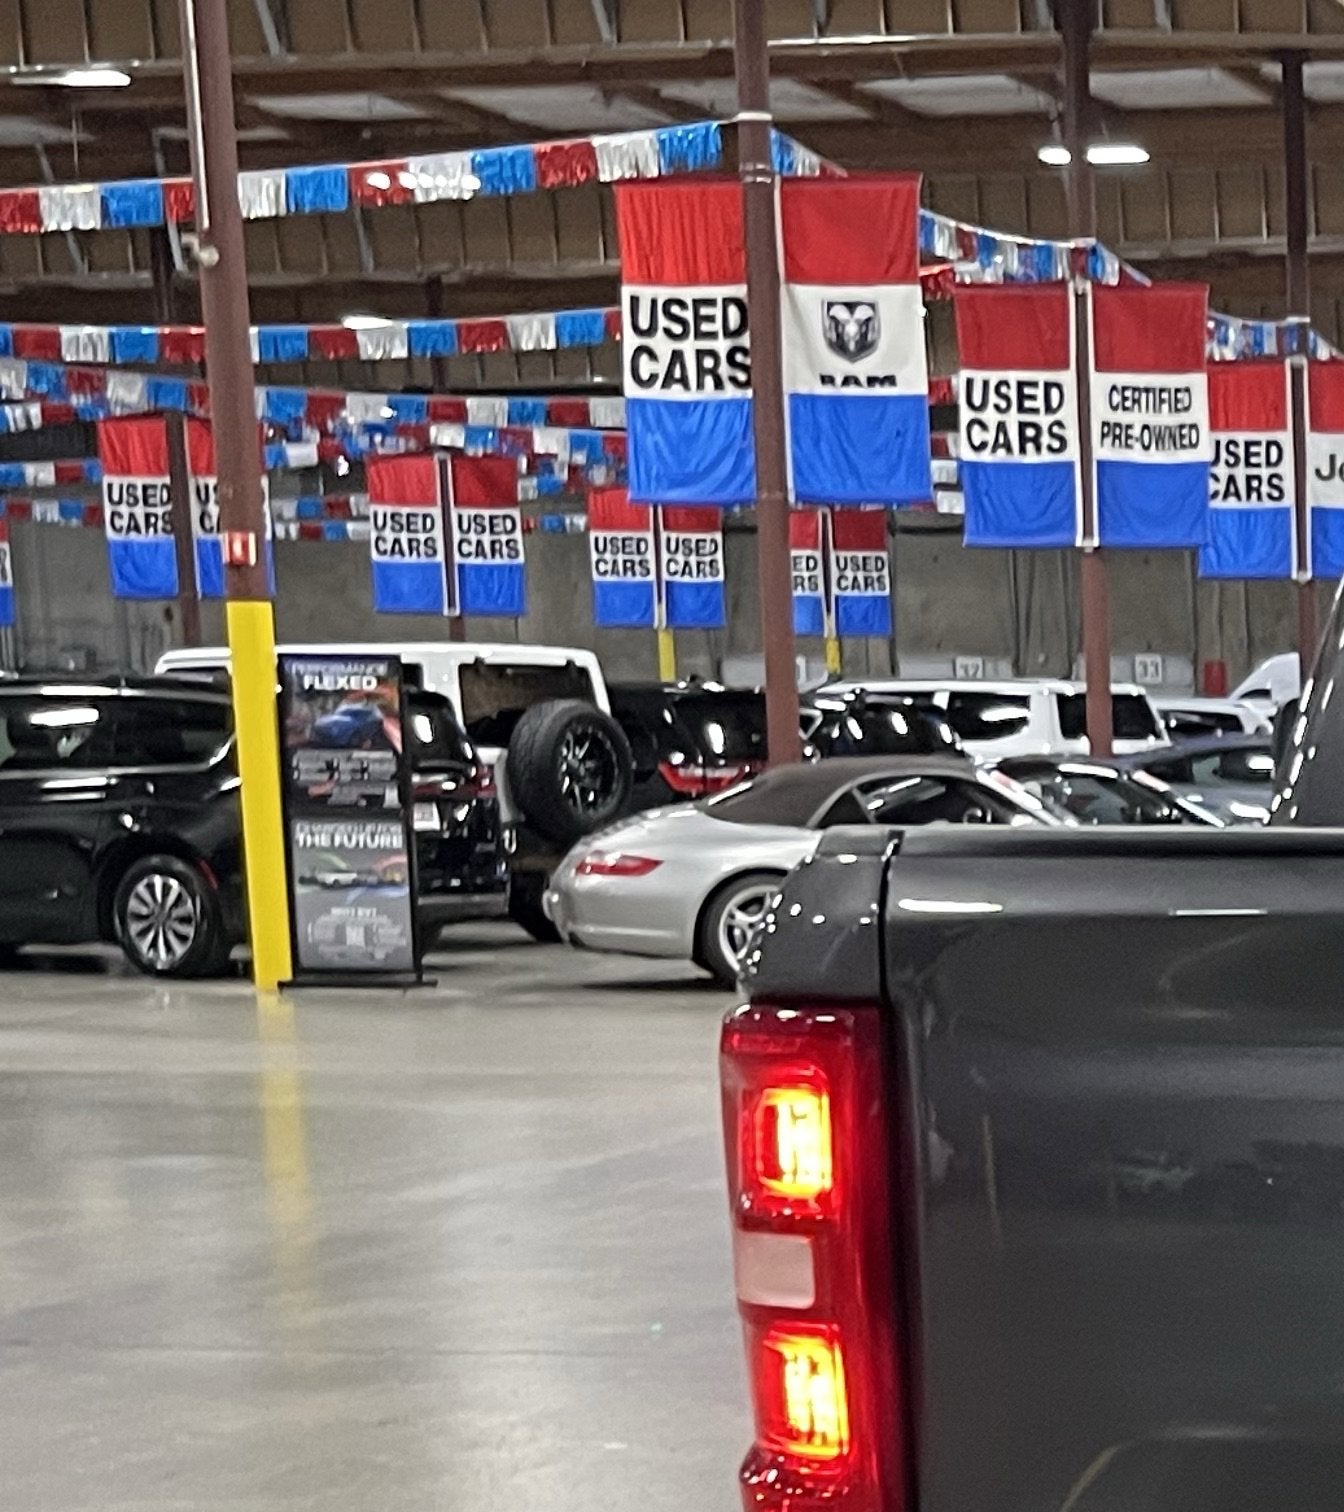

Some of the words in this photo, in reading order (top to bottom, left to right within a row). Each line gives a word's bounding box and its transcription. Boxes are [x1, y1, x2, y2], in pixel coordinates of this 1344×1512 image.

[629, 295, 748, 341] USED
[630, 345, 751, 391] CARS
[820, 373, 897, 389] RAM
[965, 378, 1065, 415] USED
[1108, 384, 1192, 413] CERTIFIED
[966, 418, 1067, 455] CARS
[1100, 421, 1199, 451] PRE-OWNED
[107, 483, 170, 507] USED
[110, 511, 173, 534] CARS
[373, 511, 435, 534] USED
[458, 514, 517, 535] USED
[374, 536, 438, 558] CARS
[458, 538, 520, 560] CARS
[595, 537, 649, 556] USED
[666, 537, 719, 556] USED
[594, 558, 650, 579] CARS
[666, 559, 720, 579] CARS
[792, 555, 818, 571] ED
[836, 555, 885, 572] USED
[793, 575, 819, 592] RS
[836, 575, 886, 591] CARS
